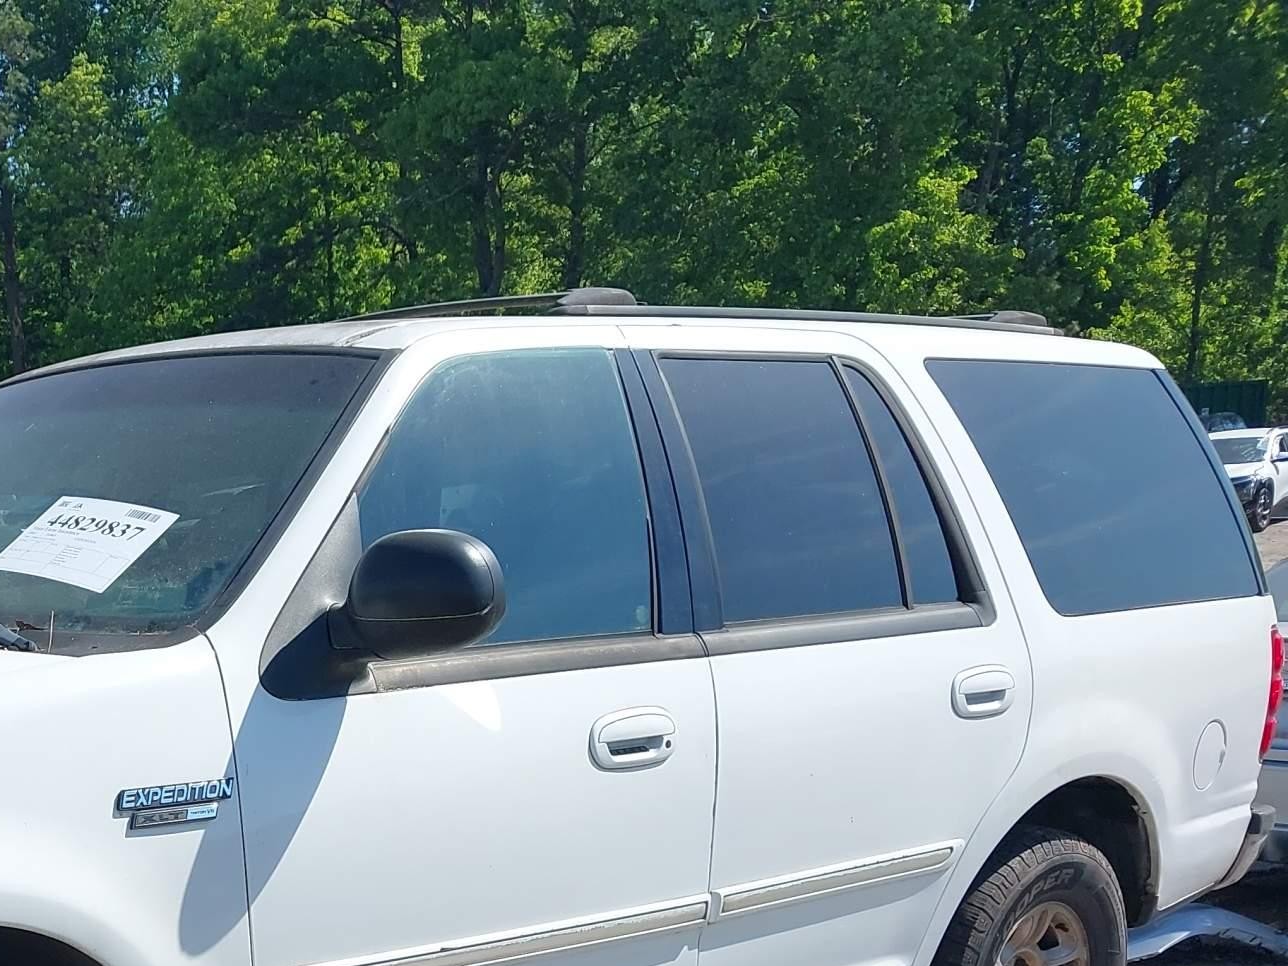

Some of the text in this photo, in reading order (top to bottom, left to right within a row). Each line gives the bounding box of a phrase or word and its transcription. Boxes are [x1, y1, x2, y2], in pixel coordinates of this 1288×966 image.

[47, 512, 147, 541] 44829837
[122, 779, 233, 808] EXPEDITION
[1001, 868, 1074, 942] OOPER
